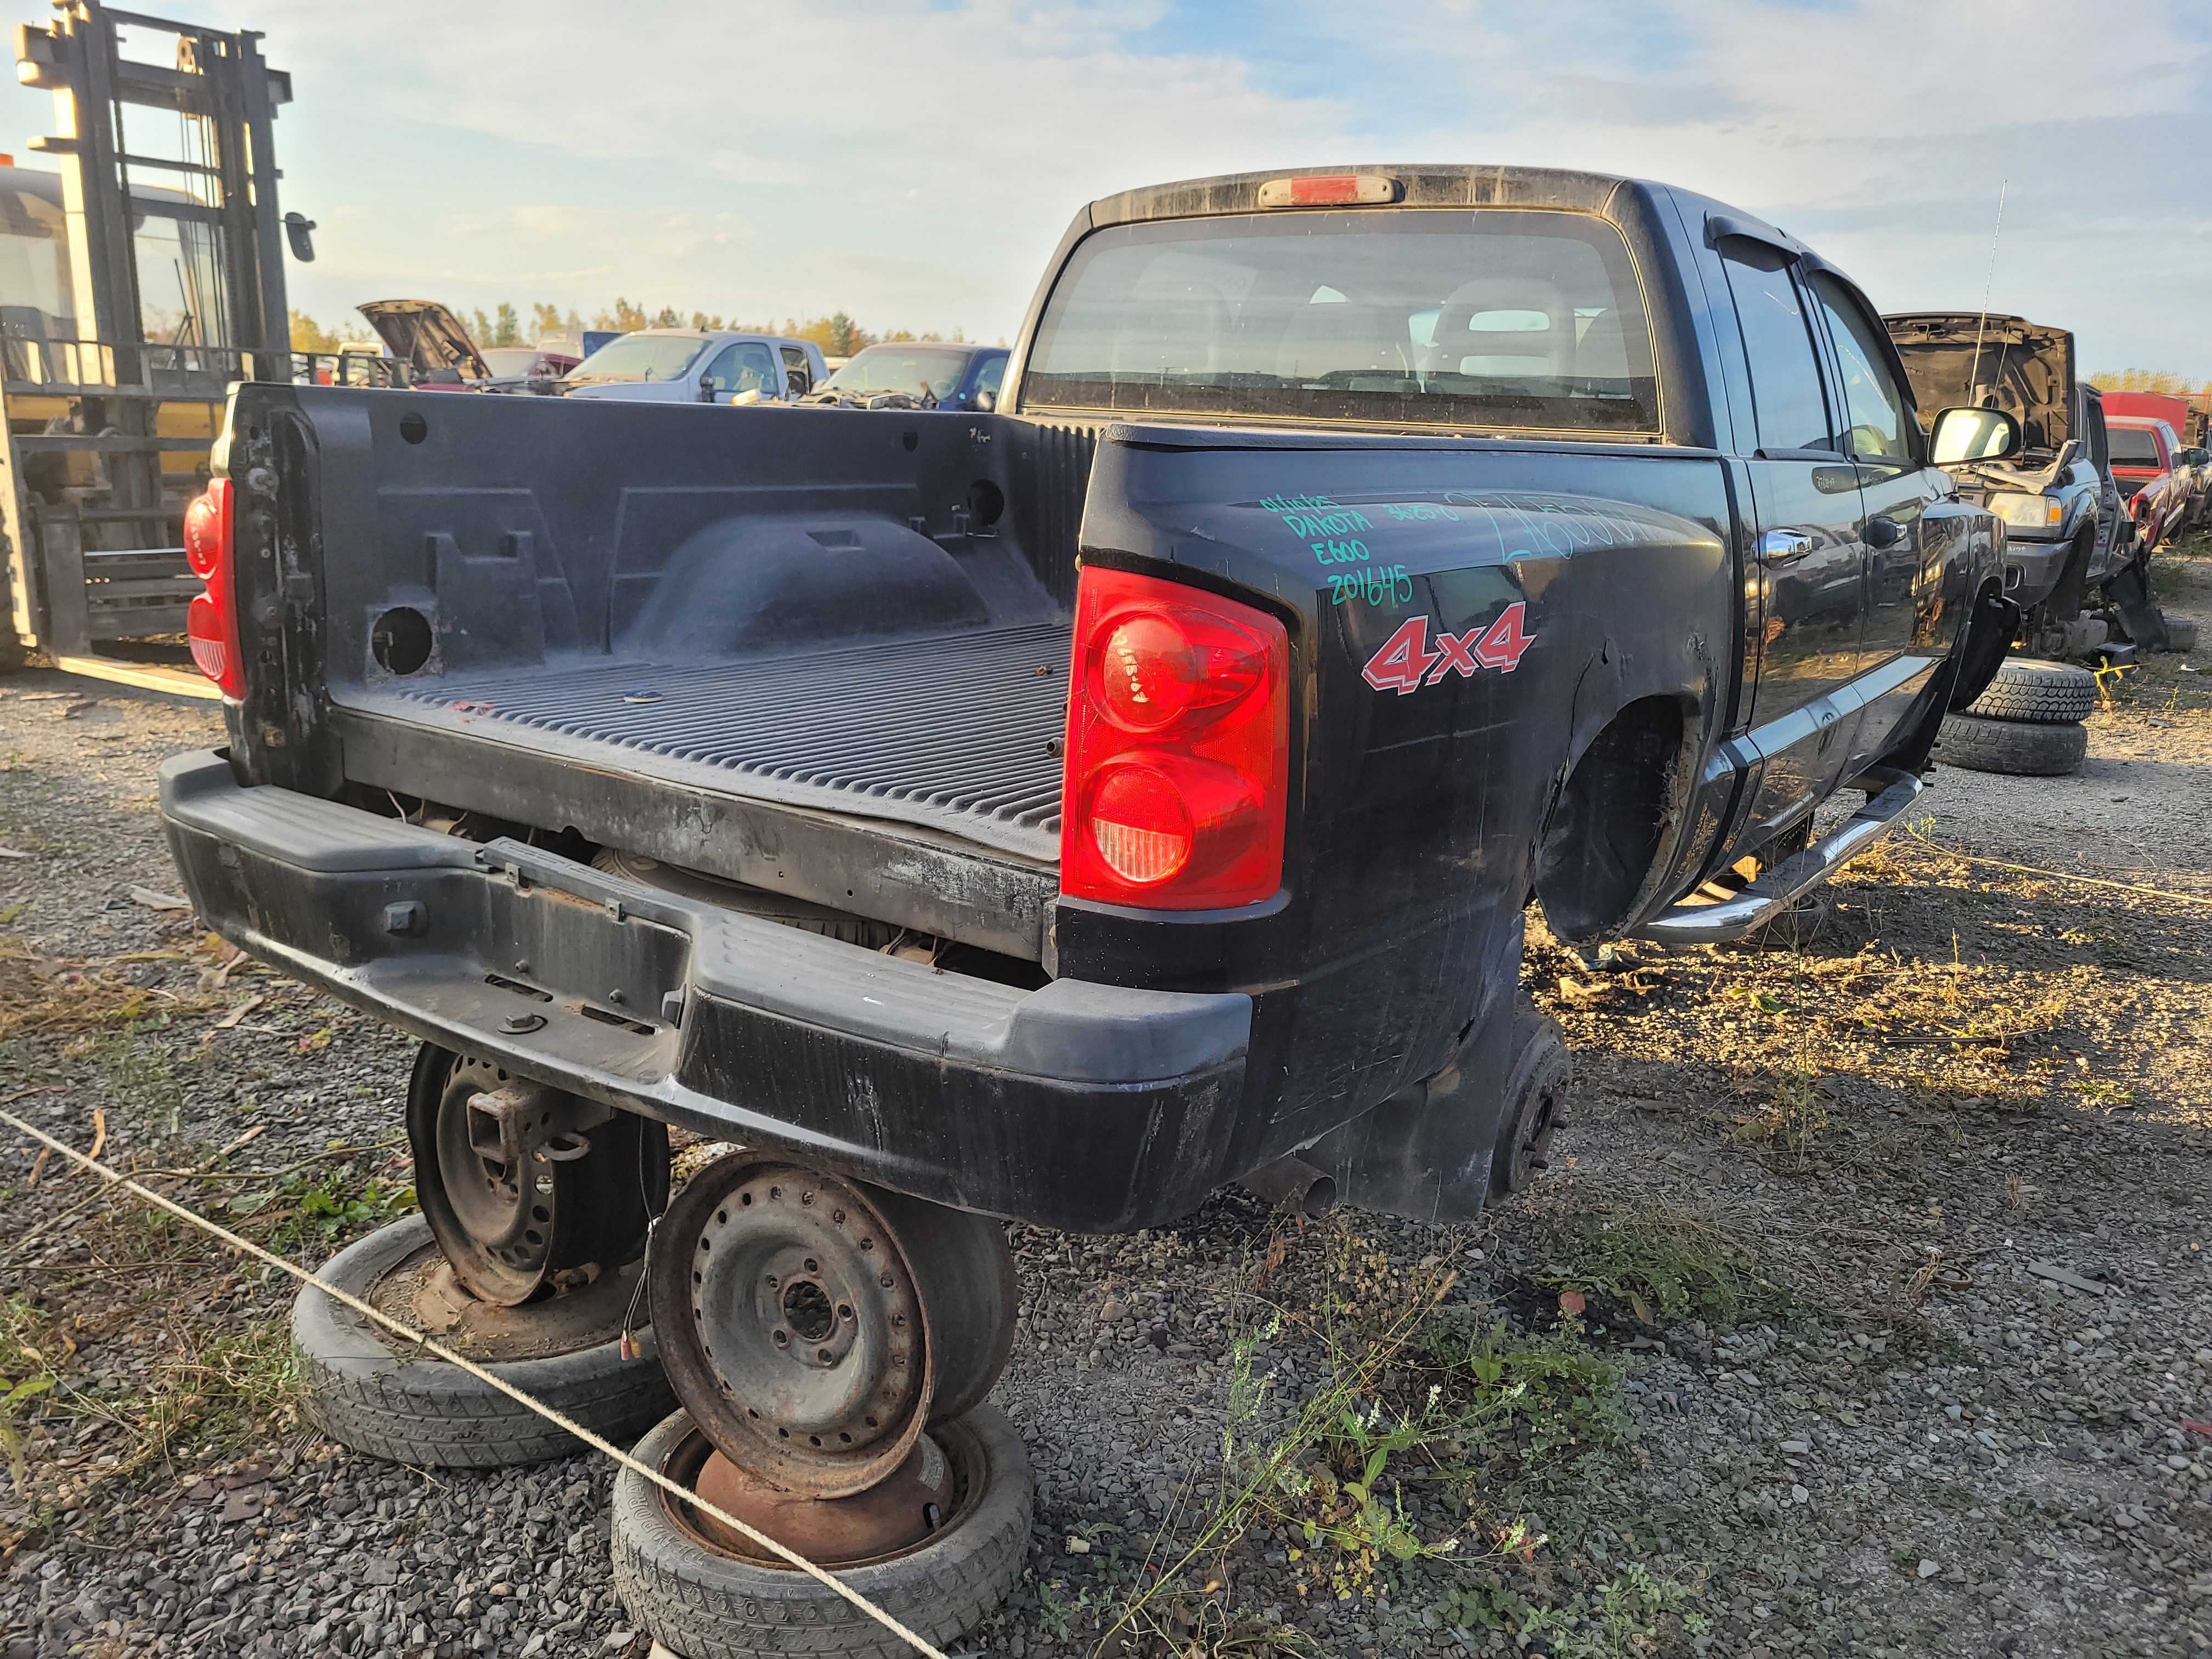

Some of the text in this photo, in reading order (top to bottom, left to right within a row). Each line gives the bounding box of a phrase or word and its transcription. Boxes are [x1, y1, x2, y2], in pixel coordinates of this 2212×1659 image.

[1282, 509, 1374, 539] DAKOTA
[1311, 539, 1370, 565] E600
[1327, 564, 1413, 606] 201645
[1361, 601, 1537, 696] 4x4
[625, 1460, 709, 1567] TEMPORAR
